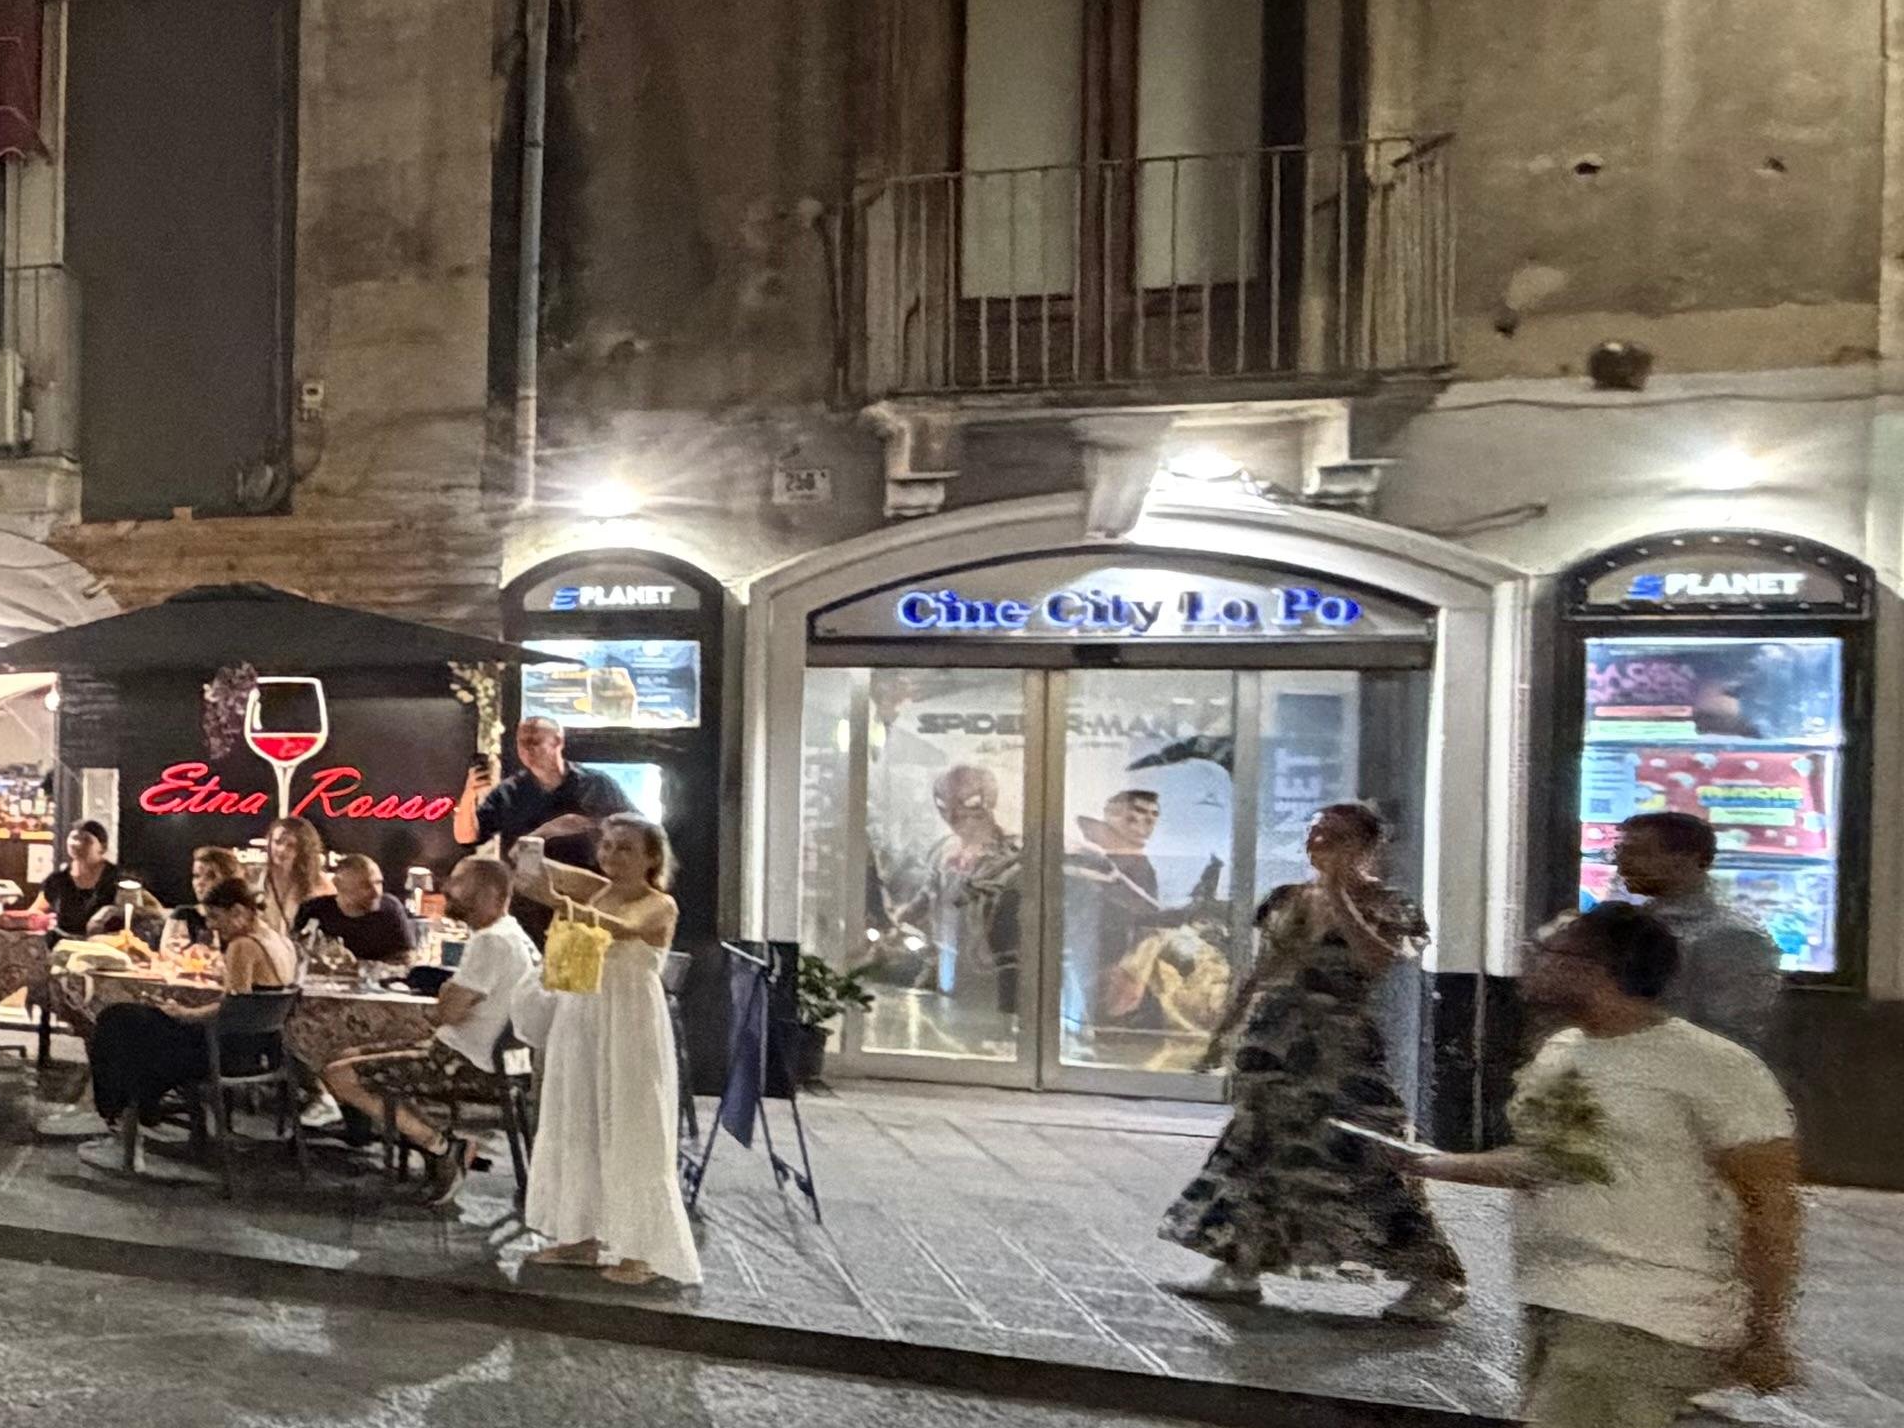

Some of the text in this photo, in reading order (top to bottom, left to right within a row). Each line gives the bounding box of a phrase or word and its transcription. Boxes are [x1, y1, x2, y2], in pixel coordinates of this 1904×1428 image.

[579, 585, 676, 605] PLANET
[1664, 572, 1807, 595] PLANET
[897, 590, 1031, 628] Cine
[1042, 590, 1162, 636] City
[140, 762, 456, 821] Etna Rosso
